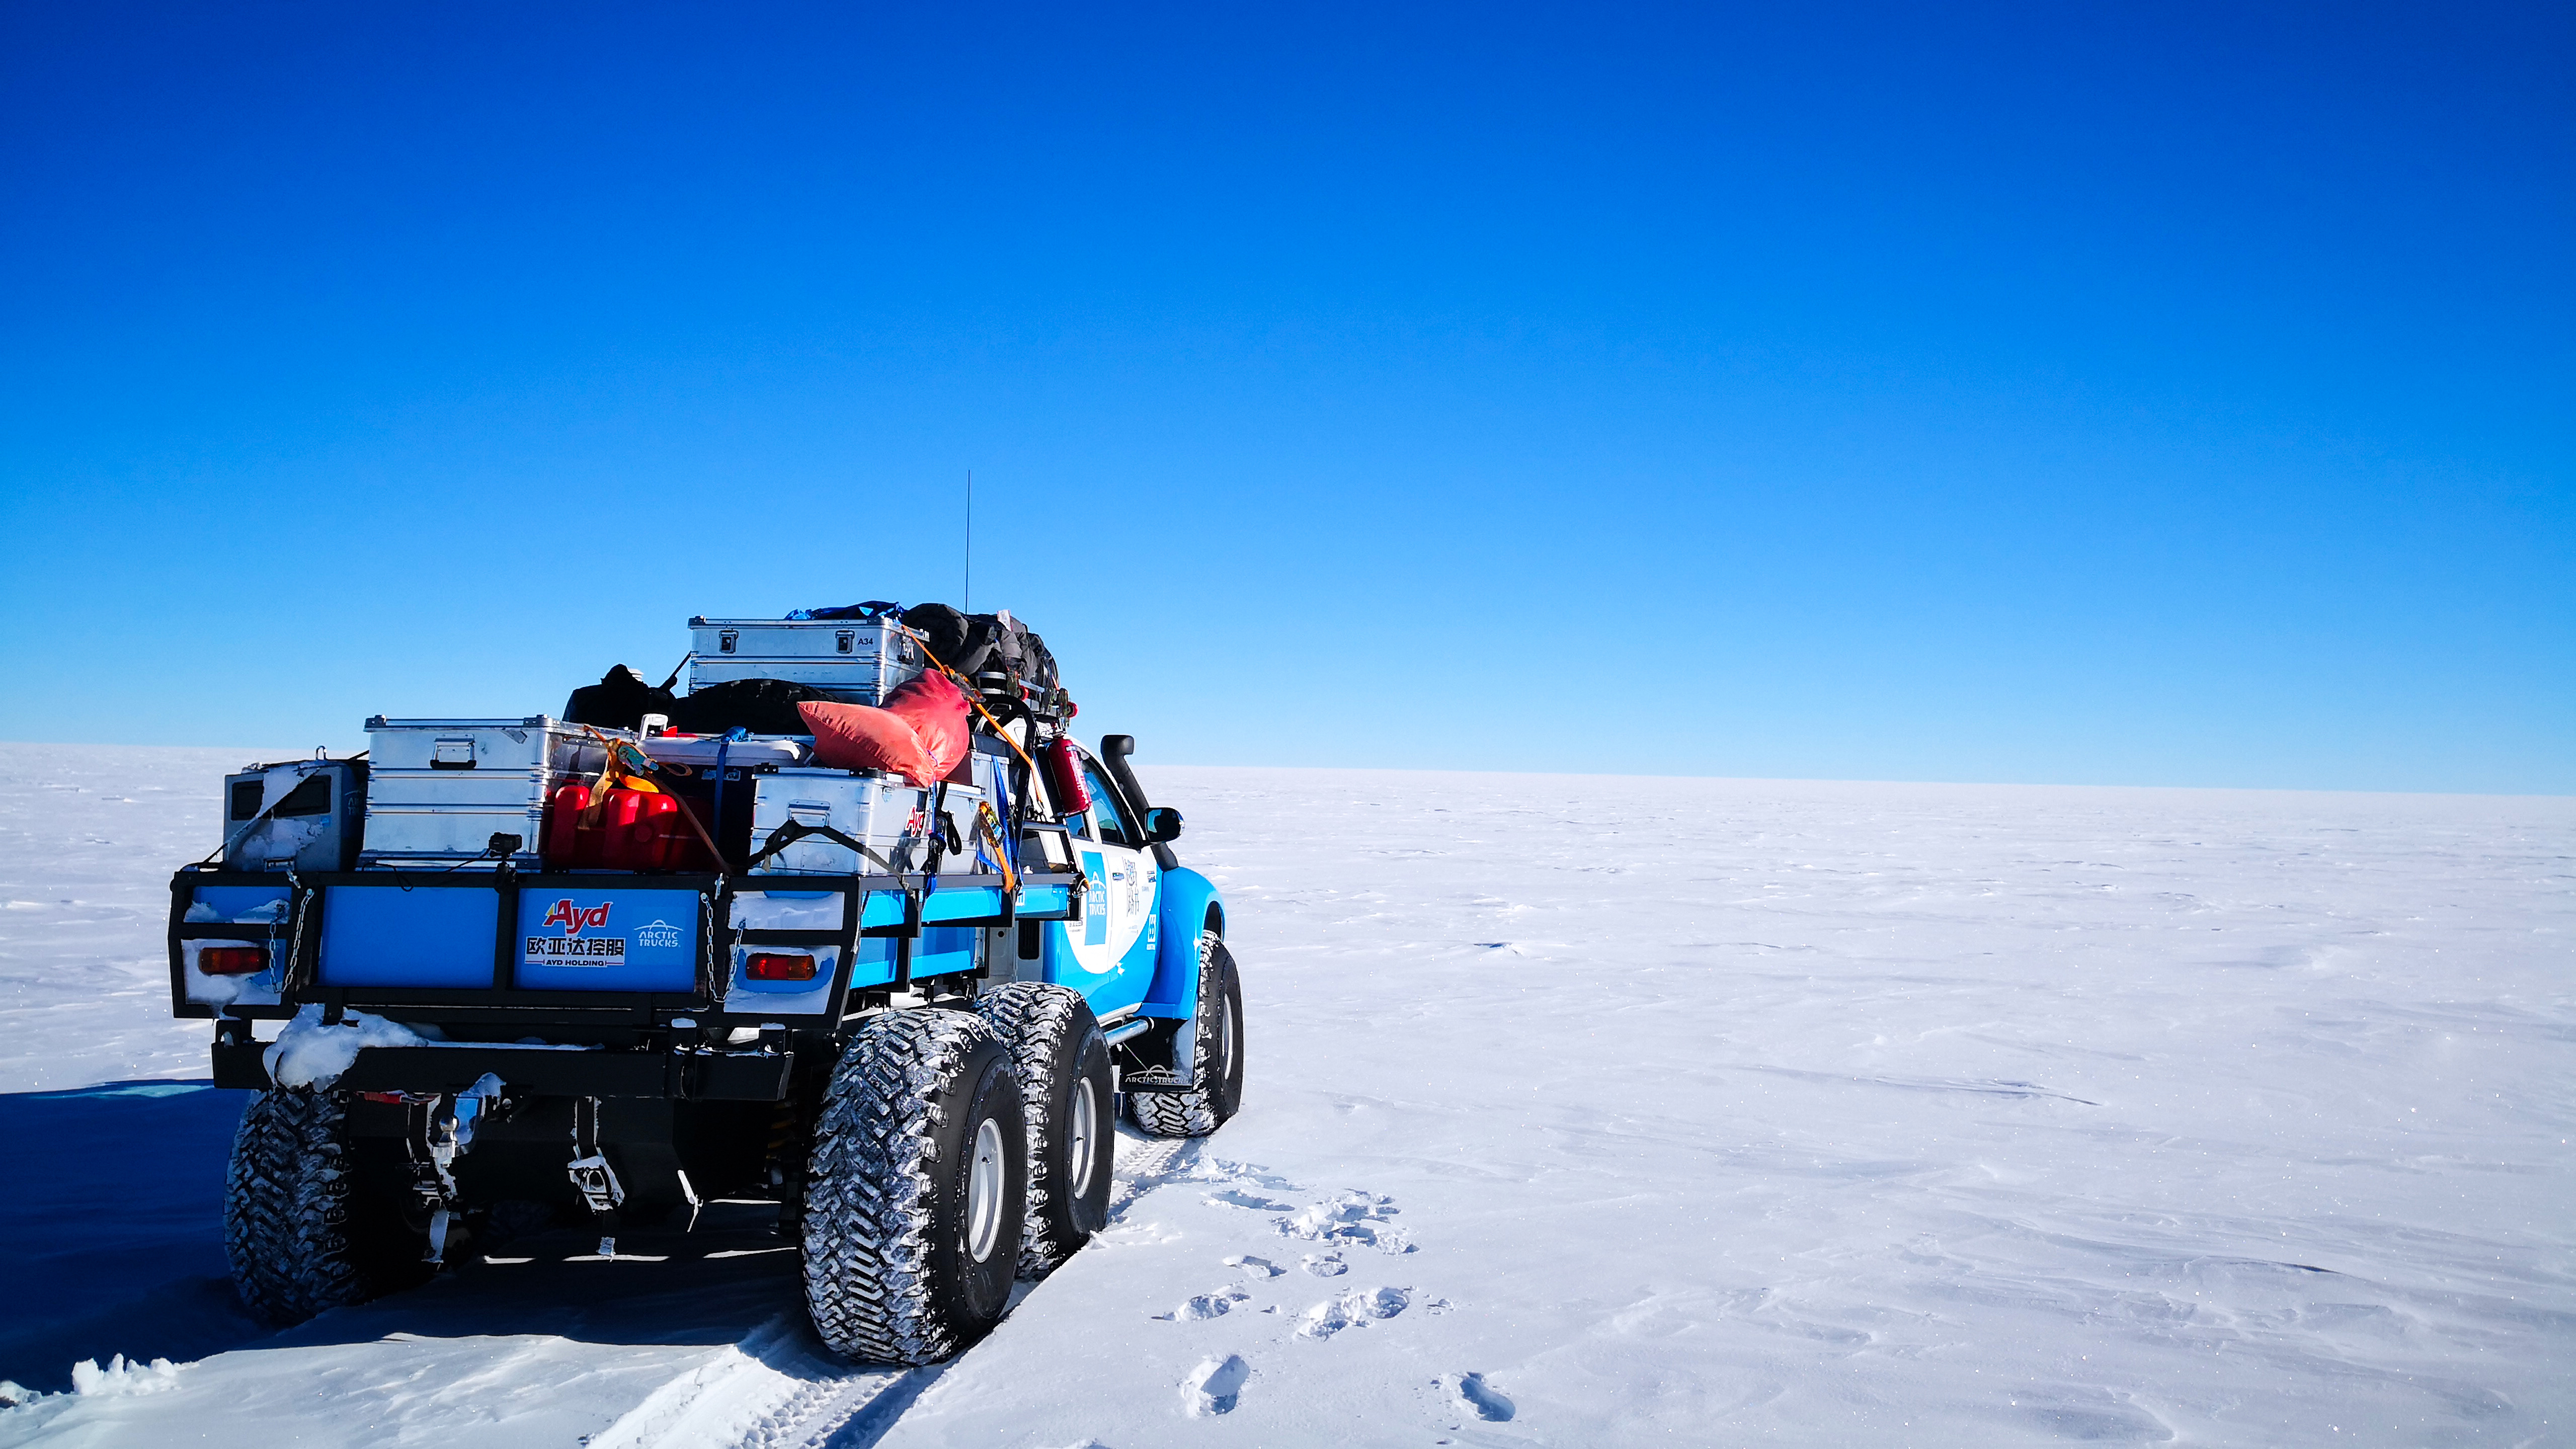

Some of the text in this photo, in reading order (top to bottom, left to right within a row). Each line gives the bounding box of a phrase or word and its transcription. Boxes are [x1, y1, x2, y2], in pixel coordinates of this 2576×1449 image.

[857, 637, 873, 646] A34
[1089, 891, 1105, 903] ARCTIC
[543, 899, 612, 934] Ayd
[638, 931, 678, 939] ARCTIC
[526, 937, 624, 956] 欧亚达控股
[638, 939, 678, 947] TRUCKS
